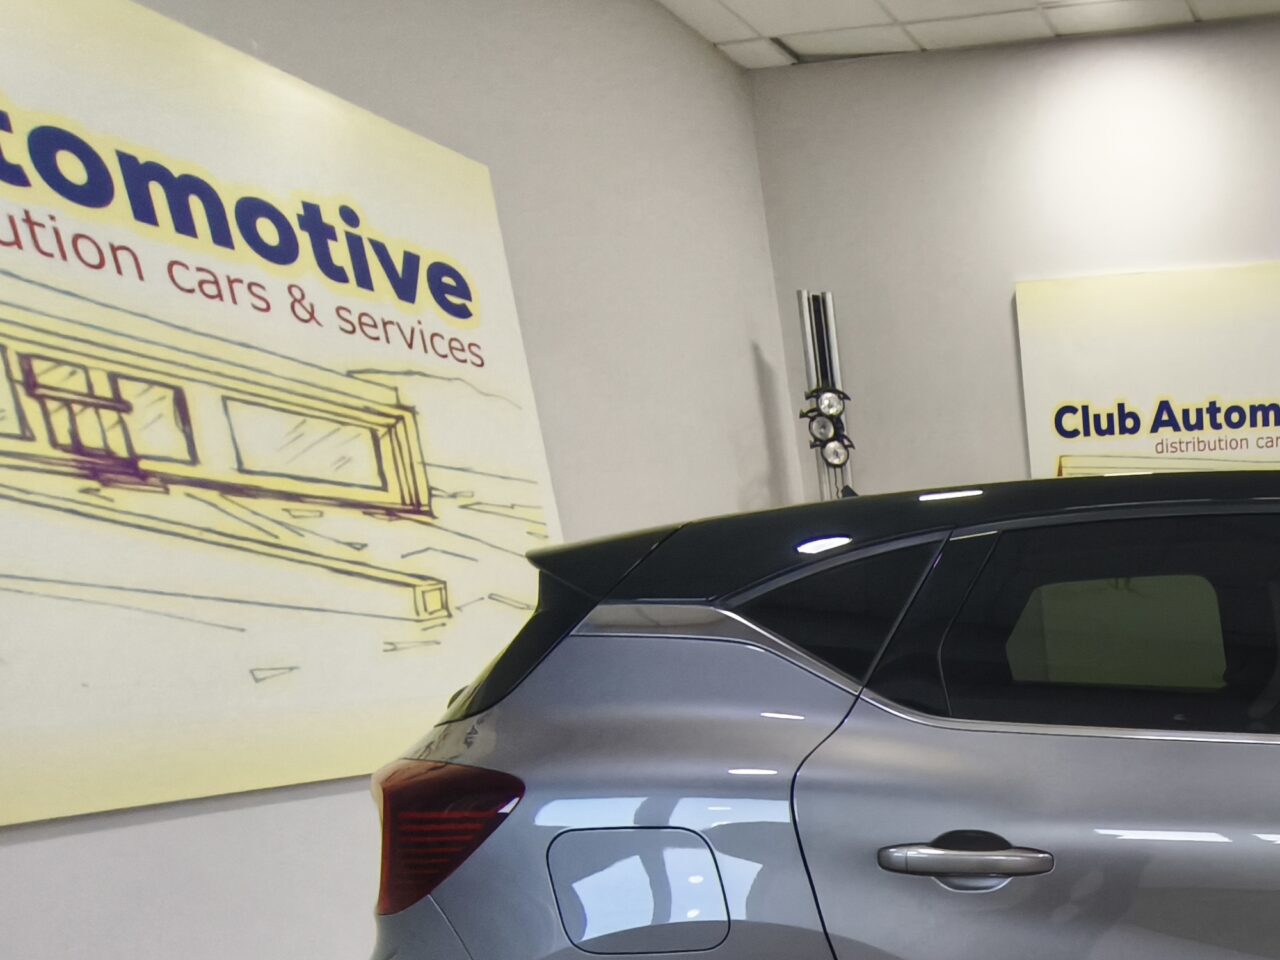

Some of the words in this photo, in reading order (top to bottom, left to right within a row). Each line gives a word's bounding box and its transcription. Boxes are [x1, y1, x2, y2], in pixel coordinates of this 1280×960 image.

[167, 258, 272, 313] cars
[286, 284, 324, 328] &
[336, 305, 486, 368] services
[1054, 403, 1141, 439] Club
[1155, 434, 1249, 454] distribution
